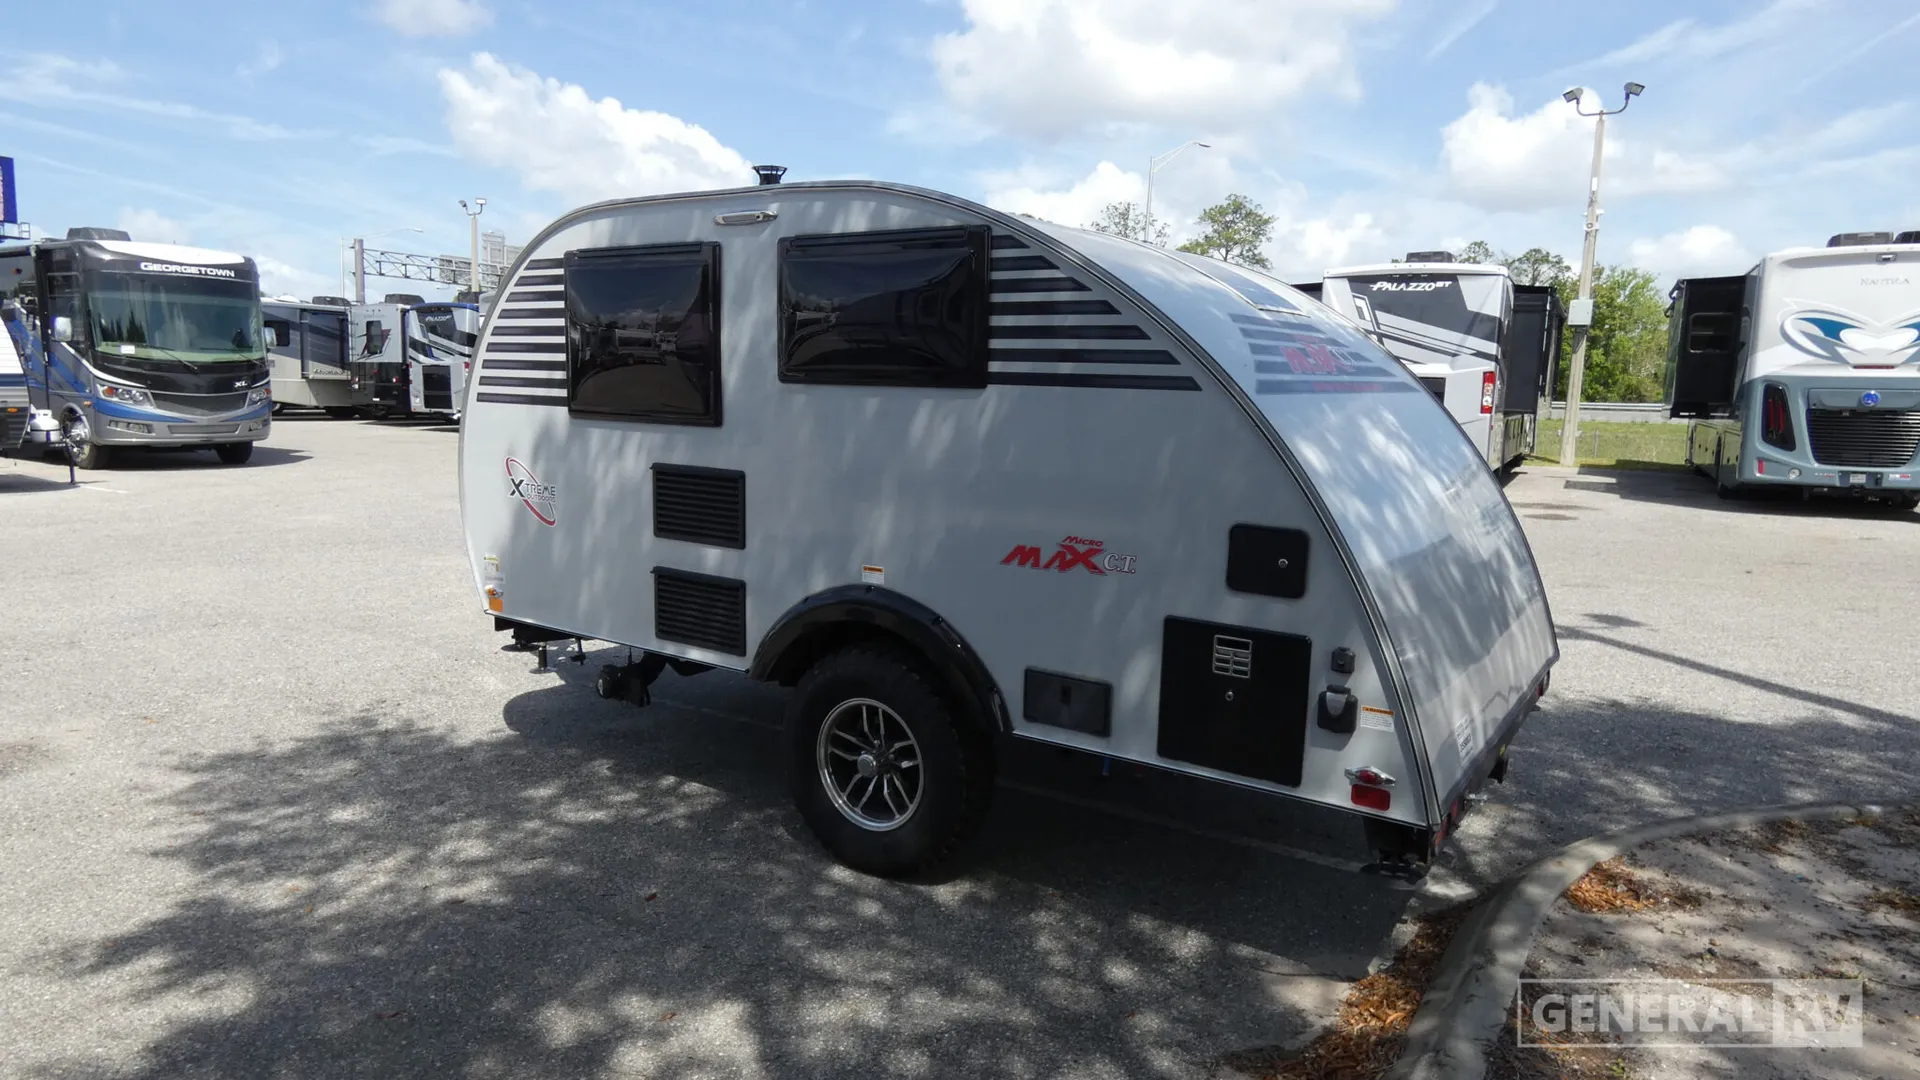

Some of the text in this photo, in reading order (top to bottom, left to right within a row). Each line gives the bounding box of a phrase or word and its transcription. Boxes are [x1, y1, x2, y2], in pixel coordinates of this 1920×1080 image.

[140, 262, 235, 277] GEORGETOWN
[1370, 281, 1436, 291] PALAZZO
[510, 478, 556, 498] XTREME
[527, 493, 556, 503] OUTDOORS
[1063, 535, 1104, 547] MICRO
[1000, 543, 1137, 576] MAX C.T.
